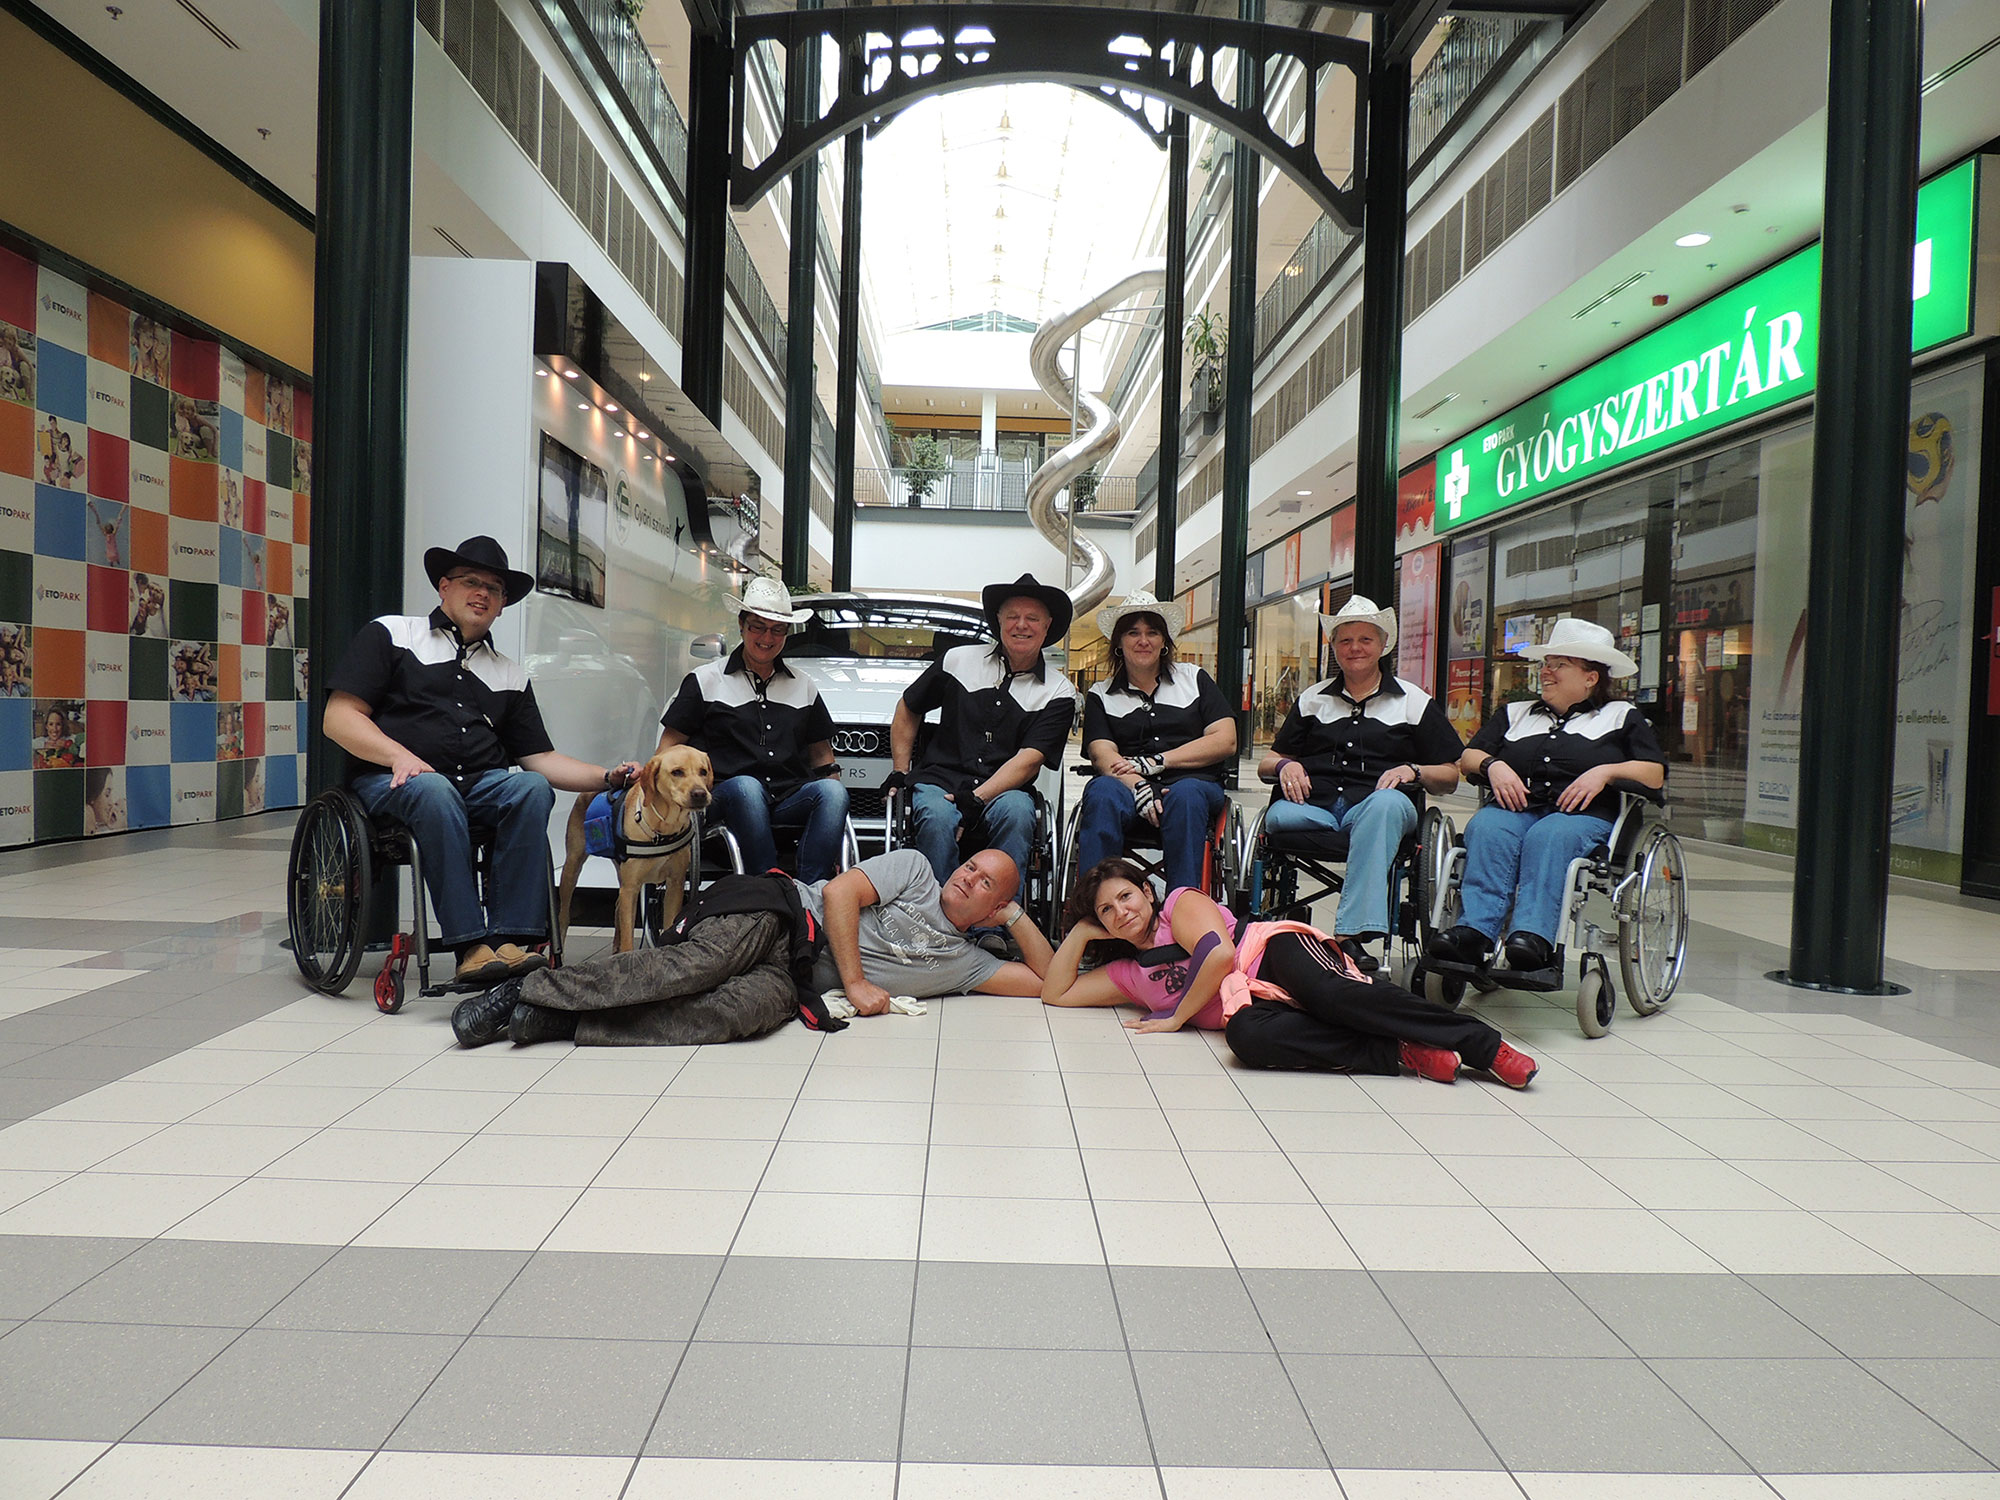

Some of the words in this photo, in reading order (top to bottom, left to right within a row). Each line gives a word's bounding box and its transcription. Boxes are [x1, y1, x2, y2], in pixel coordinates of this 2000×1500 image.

[1496, 305, 1805, 497] GYÓGYSZERTÁR
[849, 768, 867, 779] RS
[1758, 781, 1793, 795] BOIRON
[878, 907, 899, 938] FILA
